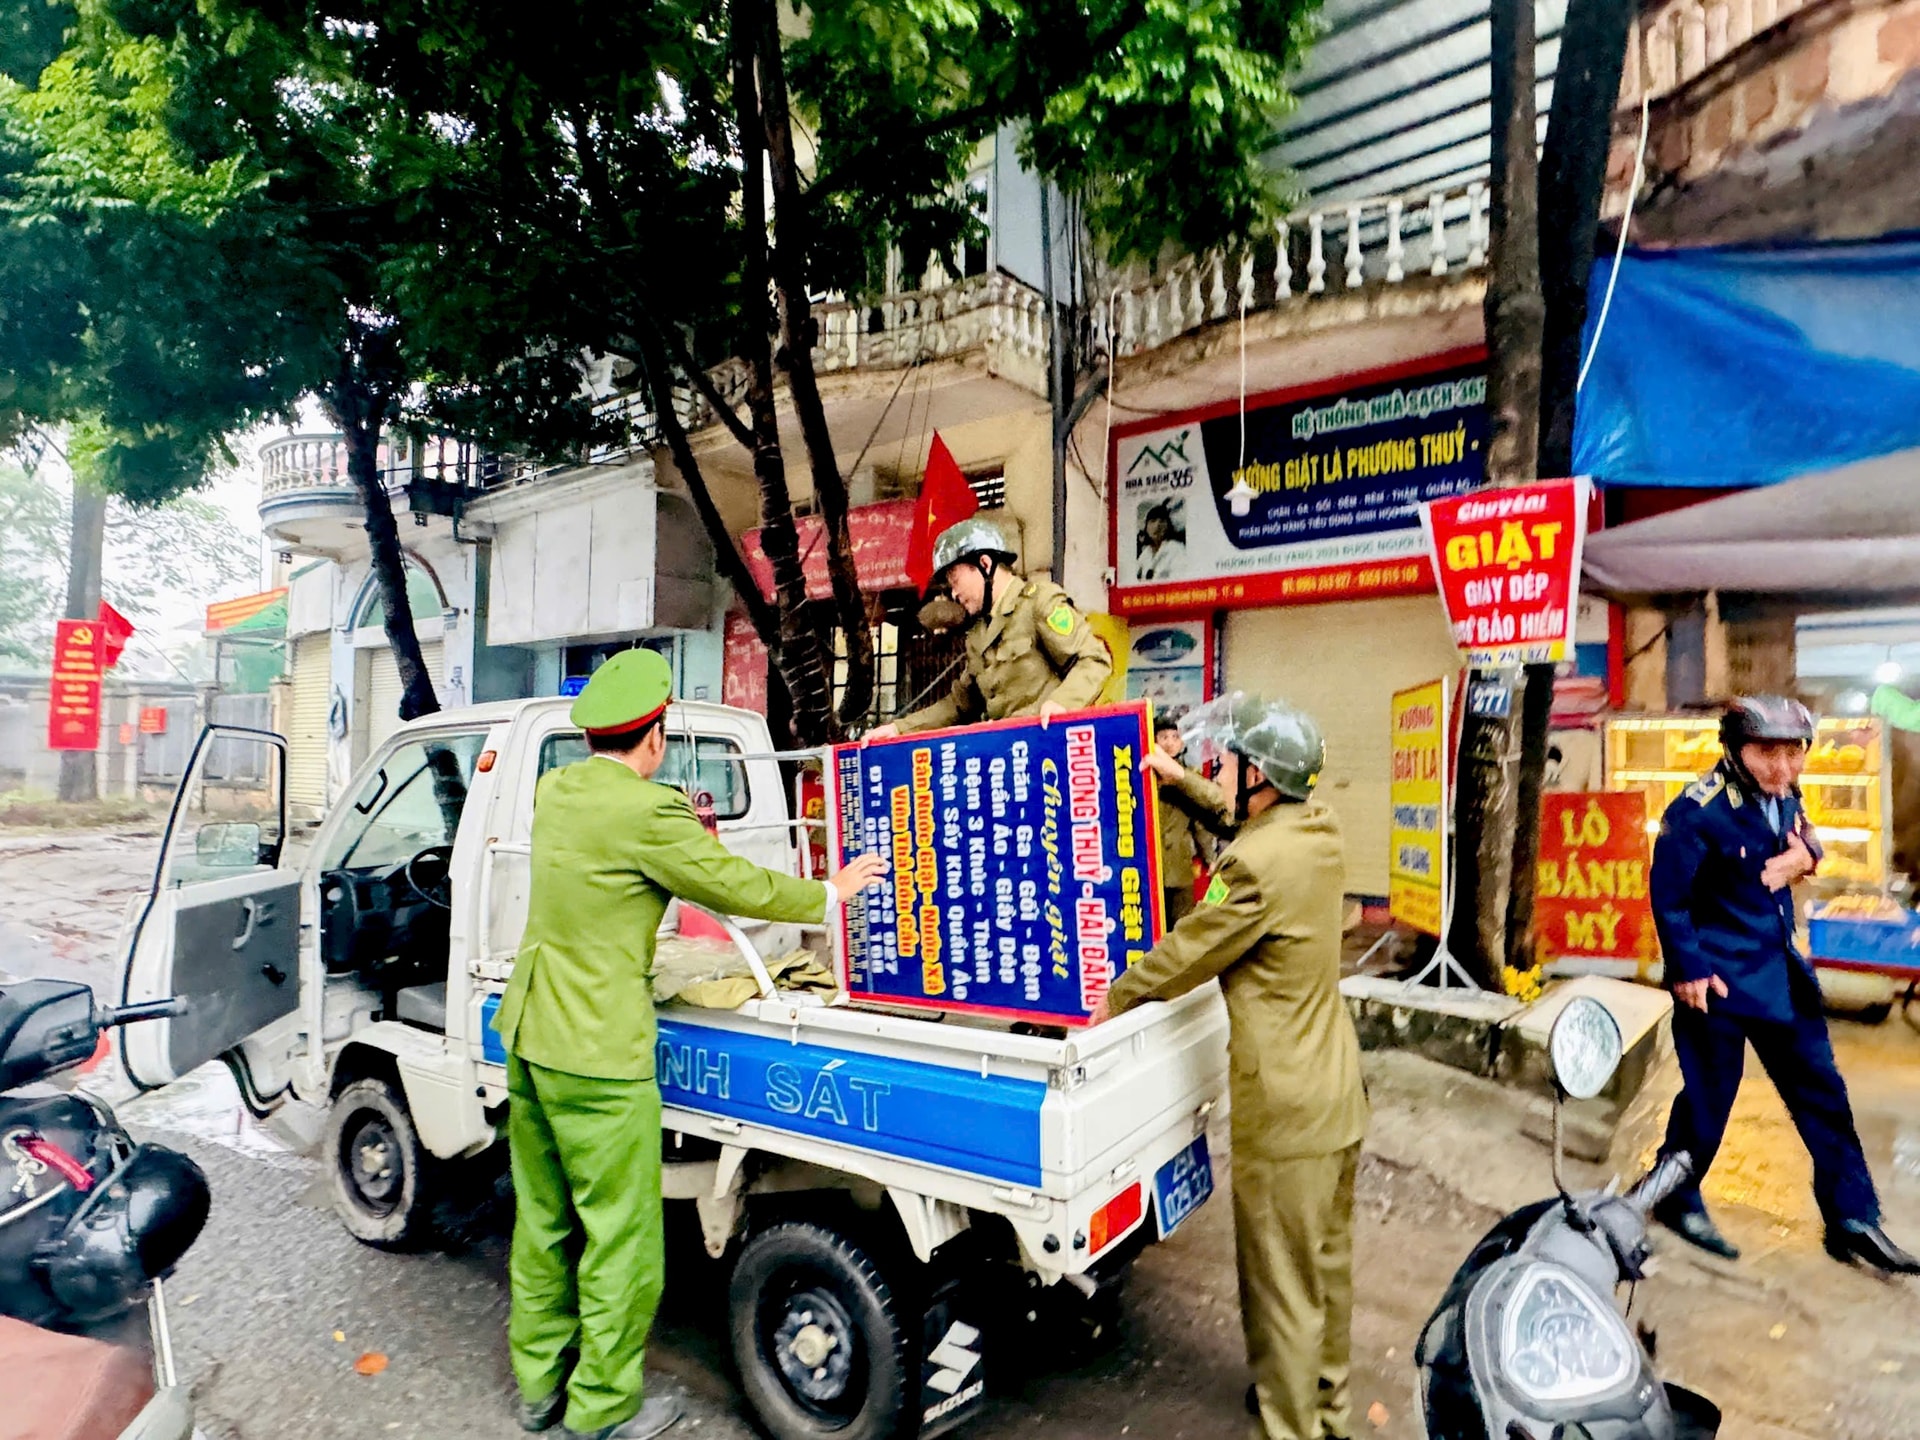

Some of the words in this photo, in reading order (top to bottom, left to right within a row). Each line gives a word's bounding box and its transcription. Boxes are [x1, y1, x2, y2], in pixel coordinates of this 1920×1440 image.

[1368, 389, 1404, 425] NHÀ
[1285, 453, 1319, 493] GIẶT
[1347, 438, 1416, 479] PHƯƠNG
[1445, 520, 1562, 571] GIẶT
[1509, 568, 1549, 602] DÉP
[1473, 685, 1507, 713] 277
[912, 748, 933, 792] Bán
[940, 742, 958, 801] Nhận
[963, 757, 982, 810] Đệm
[988, 757, 1010, 818] Quần
[1012, 740, 1030, 802] Chăn
[1066, 725, 1101, 822] PHƯƠNG
[891, 784, 911, 832] Viên
[914, 790, 936, 847] Nước
[968, 815, 984, 831] 3
[1040, 757, 1063, 894] Chuyên
[1113, 744, 1137, 858] Xưởng
[1560, 798, 1610, 847] LÒ
[893, 831, 915, 872] Thả
[943, 806, 963, 850] Sấy
[993, 823, 1012, 855] Áo
[1016, 825, 1033, 857] Ga
[1072, 822, 1112, 884] THUỶ
[915, 847, 938, 893] Giặt
[969, 836, 988, 896] Khúc
[1537, 850, 1648, 899] BÁNH
[1019, 880, 1040, 921] Gối
[1076, 898, 1116, 942] HẢI
[1120, 866, 1143, 942] Giặt
[919, 905, 942, 963] Nước
[947, 905, 969, 964] Quần
[1044, 898, 1069, 979] giặt
[1126, 949, 1145, 969] L
[952, 968, 972, 1000] Áo
[999, 936, 1018, 984] Dép
[1020, 944, 1041, 1001] Đệm
[657, 1041, 730, 1099] NH
[766, 1058, 891, 1132] SÁT
